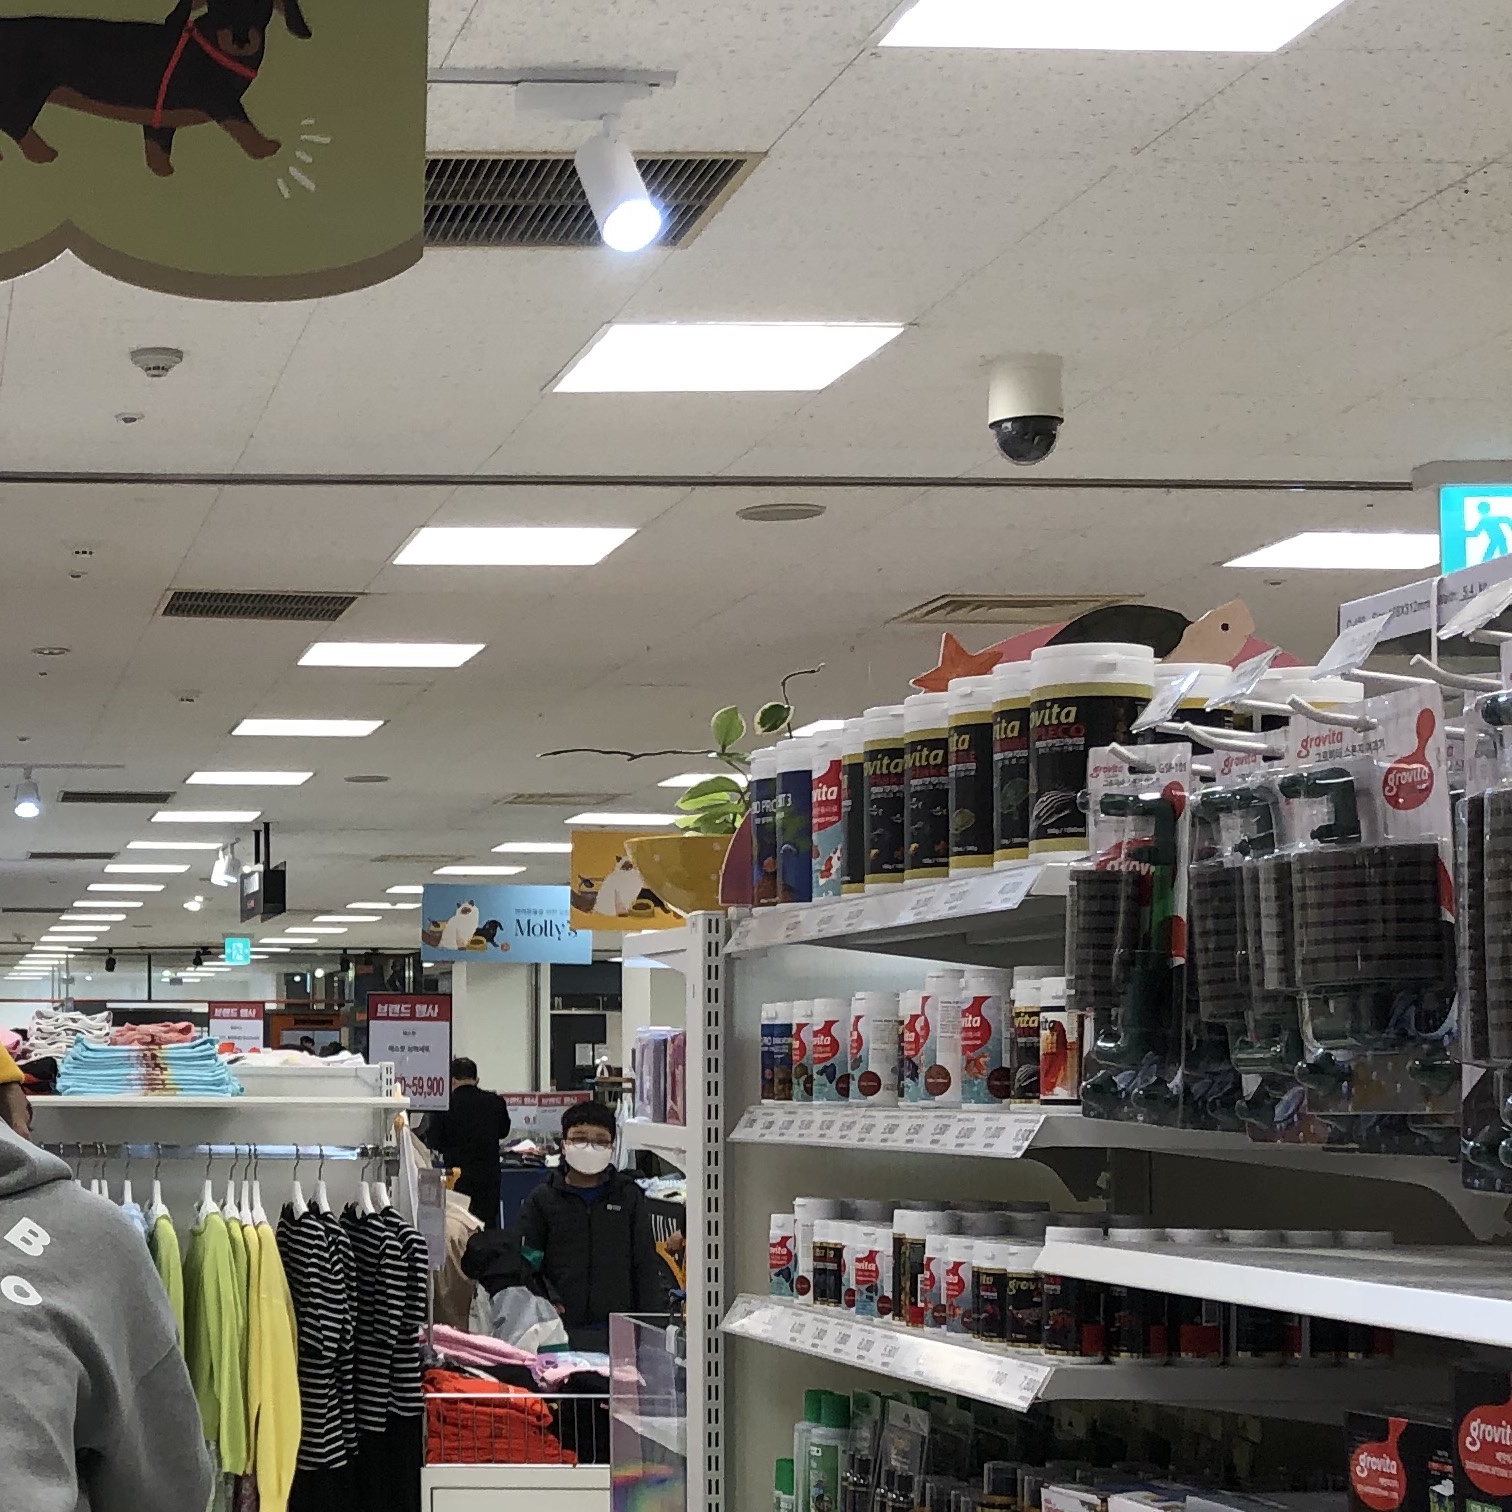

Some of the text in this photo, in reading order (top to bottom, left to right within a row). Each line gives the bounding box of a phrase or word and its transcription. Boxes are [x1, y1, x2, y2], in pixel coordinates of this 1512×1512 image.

[1297, 730, 1343, 759] grovita
[1384, 767, 1430, 796] grovita
[515, 918, 578, 941] Molly's
[376, 1003, 439, 1017] 브랜드 행사
[1465, 1418, 1512, 1452] grovit
[1356, 1452, 1397, 1477] grovita
